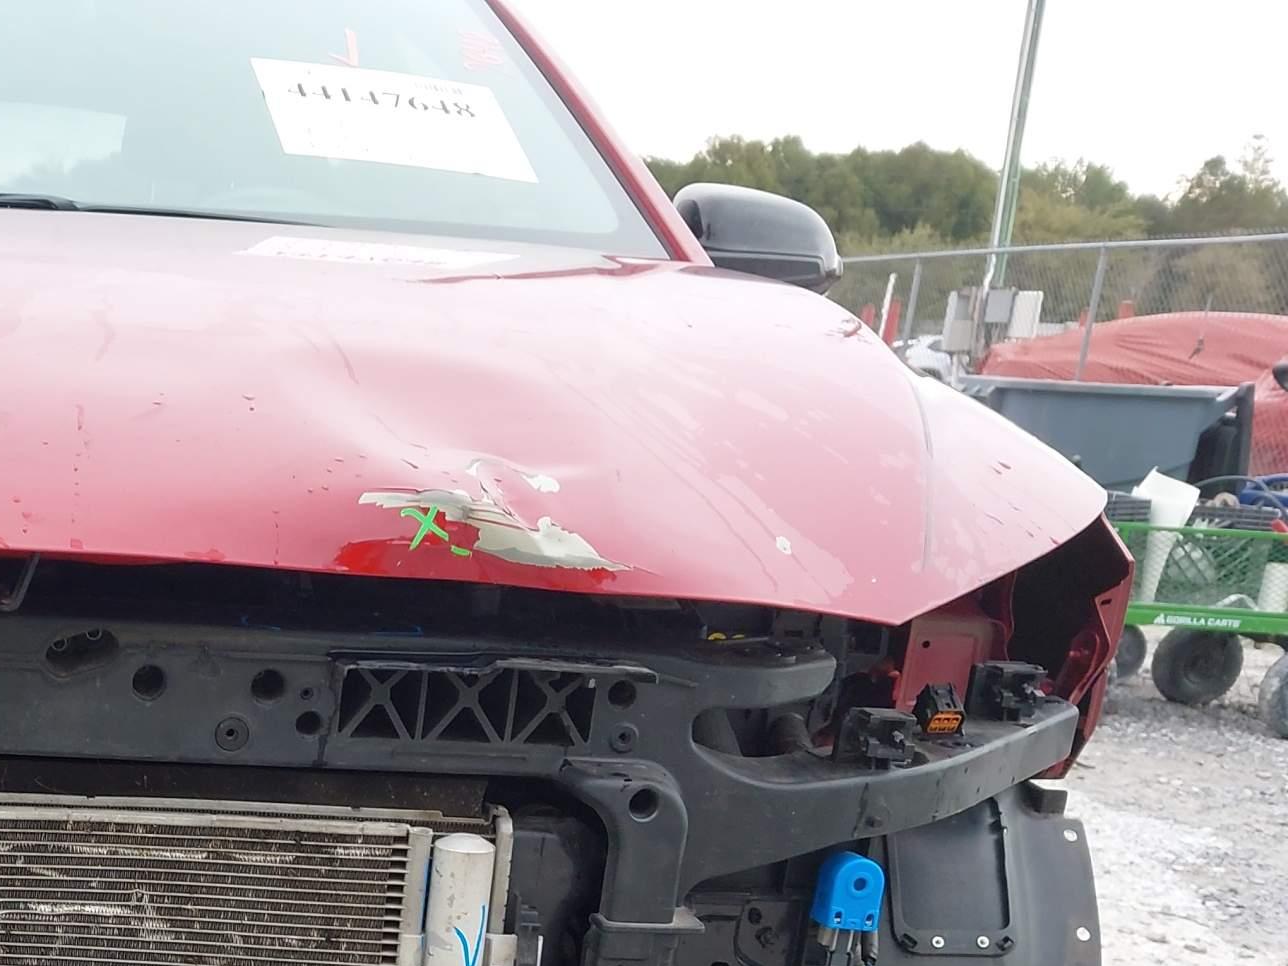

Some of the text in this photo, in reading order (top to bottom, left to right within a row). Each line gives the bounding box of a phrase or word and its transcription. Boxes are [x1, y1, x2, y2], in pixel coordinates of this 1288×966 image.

[288, 82, 477, 118] 44147648
[1166, 615, 1241, 628] GORILLA CARTS
